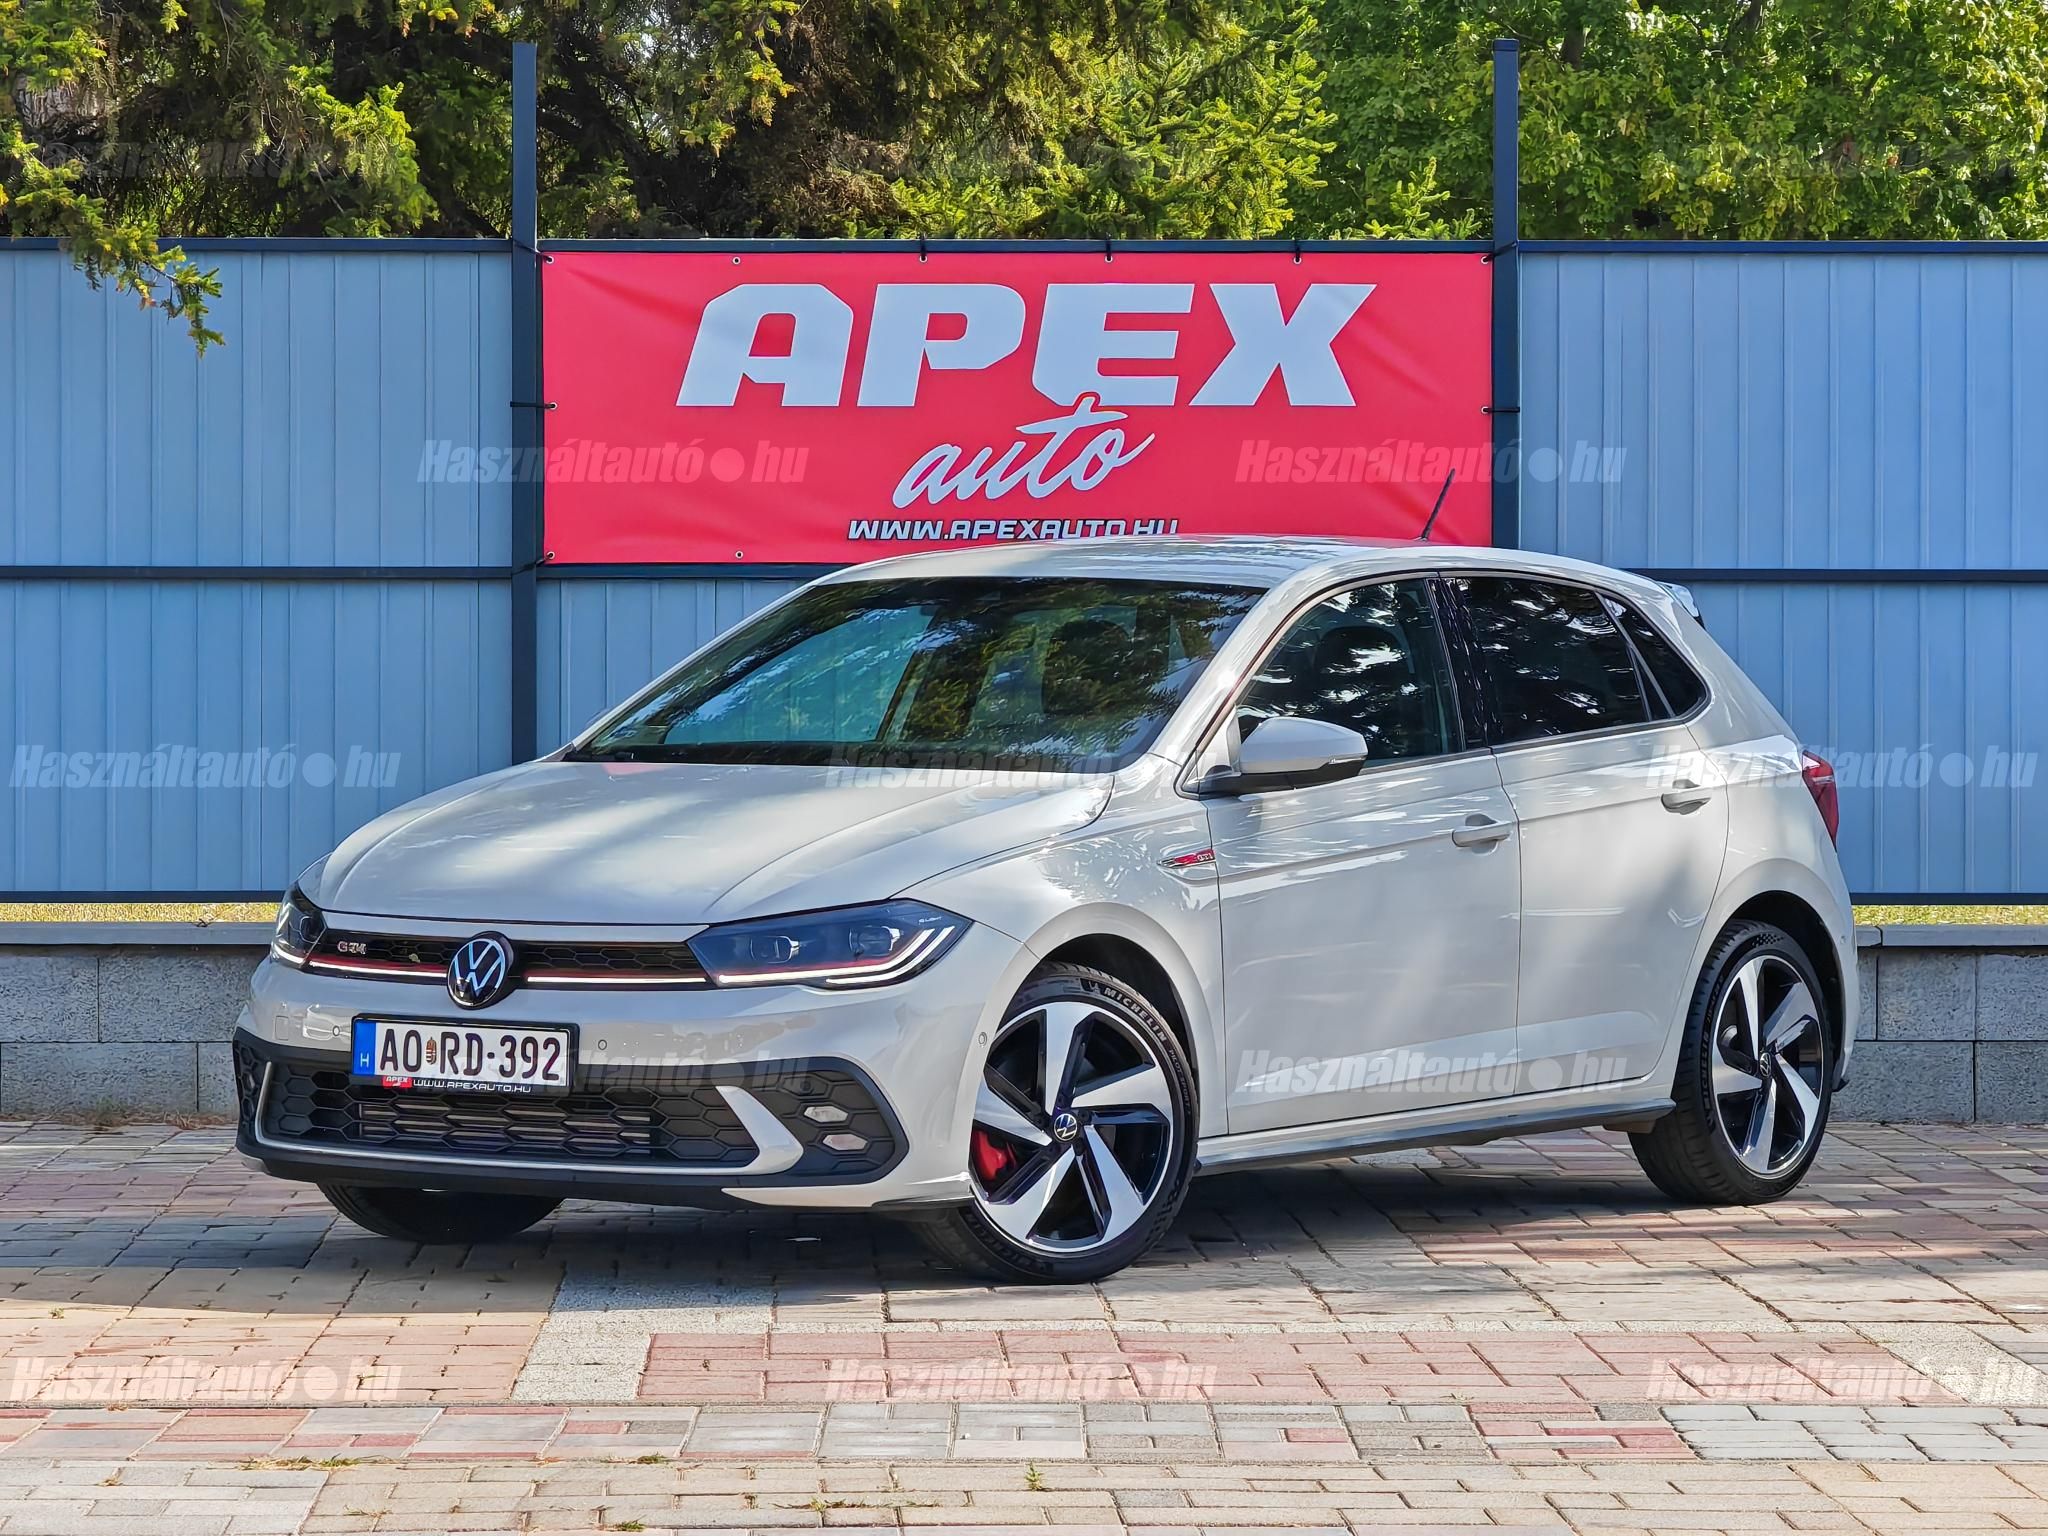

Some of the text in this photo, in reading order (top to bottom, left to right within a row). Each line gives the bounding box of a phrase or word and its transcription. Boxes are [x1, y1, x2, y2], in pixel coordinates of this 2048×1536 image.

[676, 283, 1378, 407] APEX
[892, 394, 1156, 509] auto
[1104, 987, 1167, 1042] MICHELIN
[360, 1052, 369, 1068] H
[413, 1080, 531, 1093] WWW.APEXAUTO.HU
